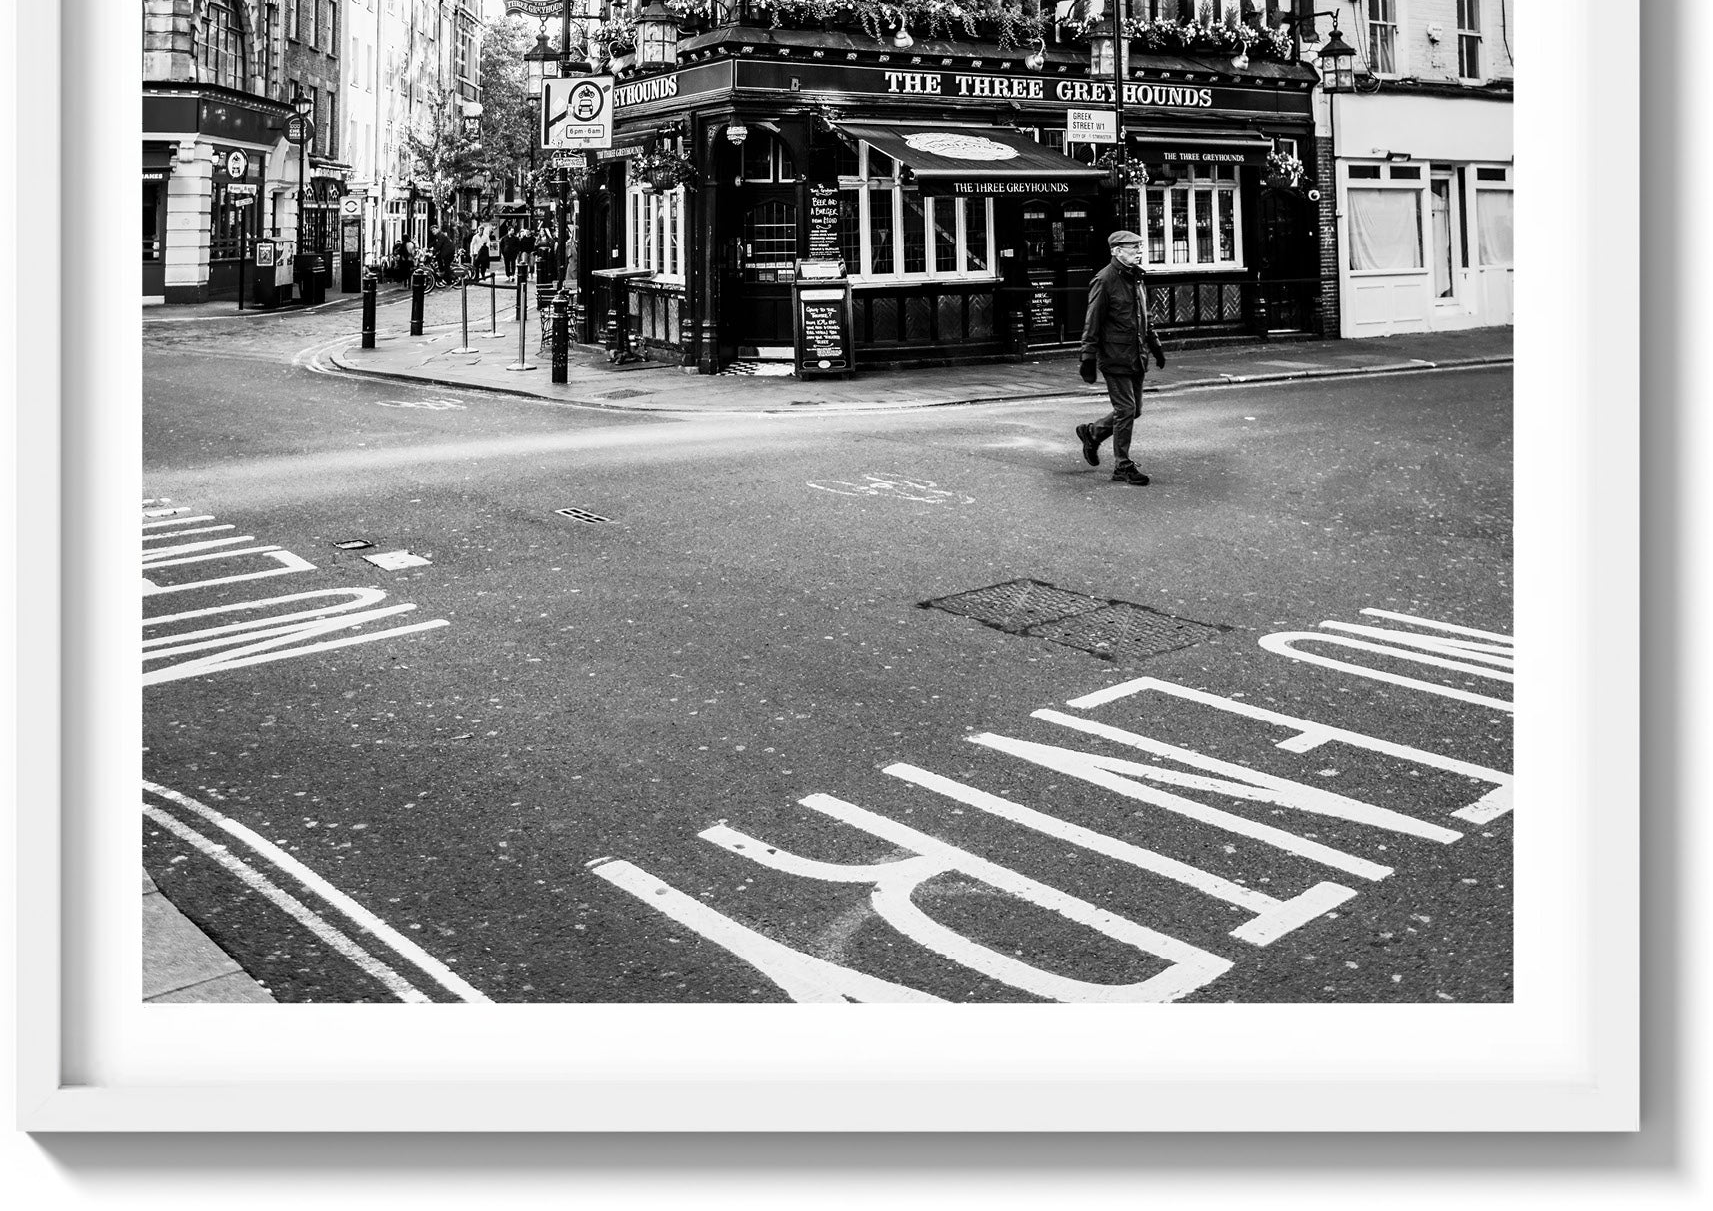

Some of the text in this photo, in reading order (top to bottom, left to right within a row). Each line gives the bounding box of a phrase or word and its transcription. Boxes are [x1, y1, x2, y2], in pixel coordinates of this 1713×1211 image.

[507, 0, 573, 14] THREE GREYHOUN
[884, 71, 1212, 107] THE THREE GREYHOUNDS
[1072, 112, 1092, 120] GREEK
[1072, 122, 1094, 130] STREET
[616, 145, 645, 157] GREYHOUNDS
[1163, 152, 1245, 162] THE THREE GREYHOUNDS
[953, 182, 1069, 192] THE THREE GREYHOUNDS
